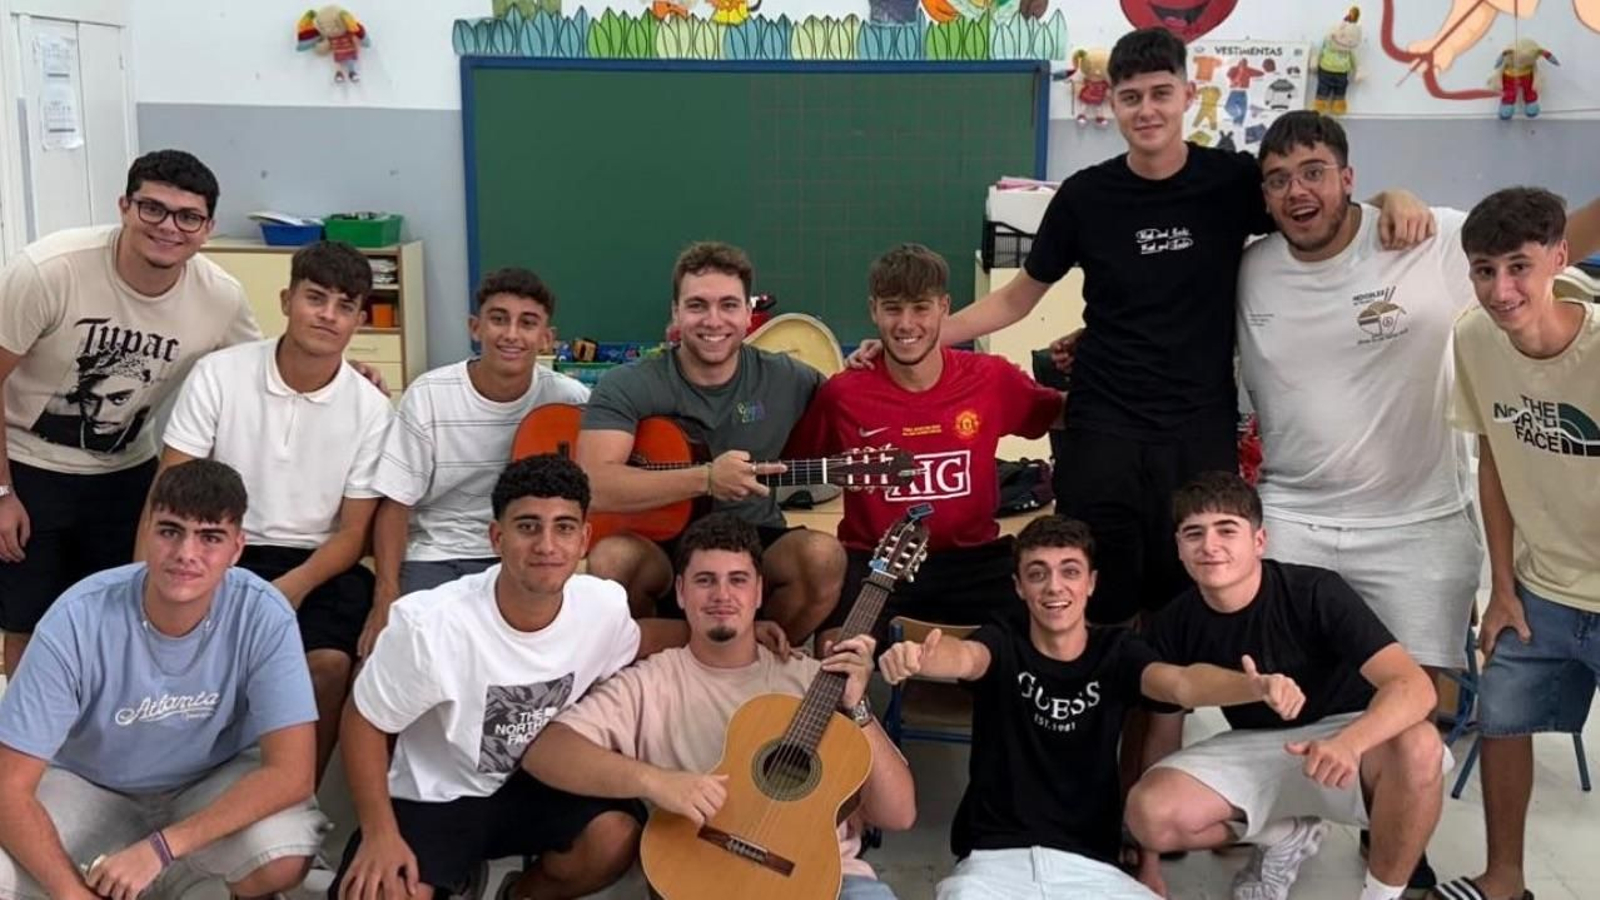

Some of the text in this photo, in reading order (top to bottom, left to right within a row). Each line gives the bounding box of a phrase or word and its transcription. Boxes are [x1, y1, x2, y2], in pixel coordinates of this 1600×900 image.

[1214, 46, 1283, 56] VESTIMENTAS
[73, 317, 180, 363] Tupac
[1520, 393, 1557, 421] THE
[1515, 425, 1560, 454] FACE
[114, 690, 220, 726] Atlanta
[1017, 671, 1100, 720] GUESS
[519, 707, 543, 722] THE
[507, 731, 536, 746] FAC
